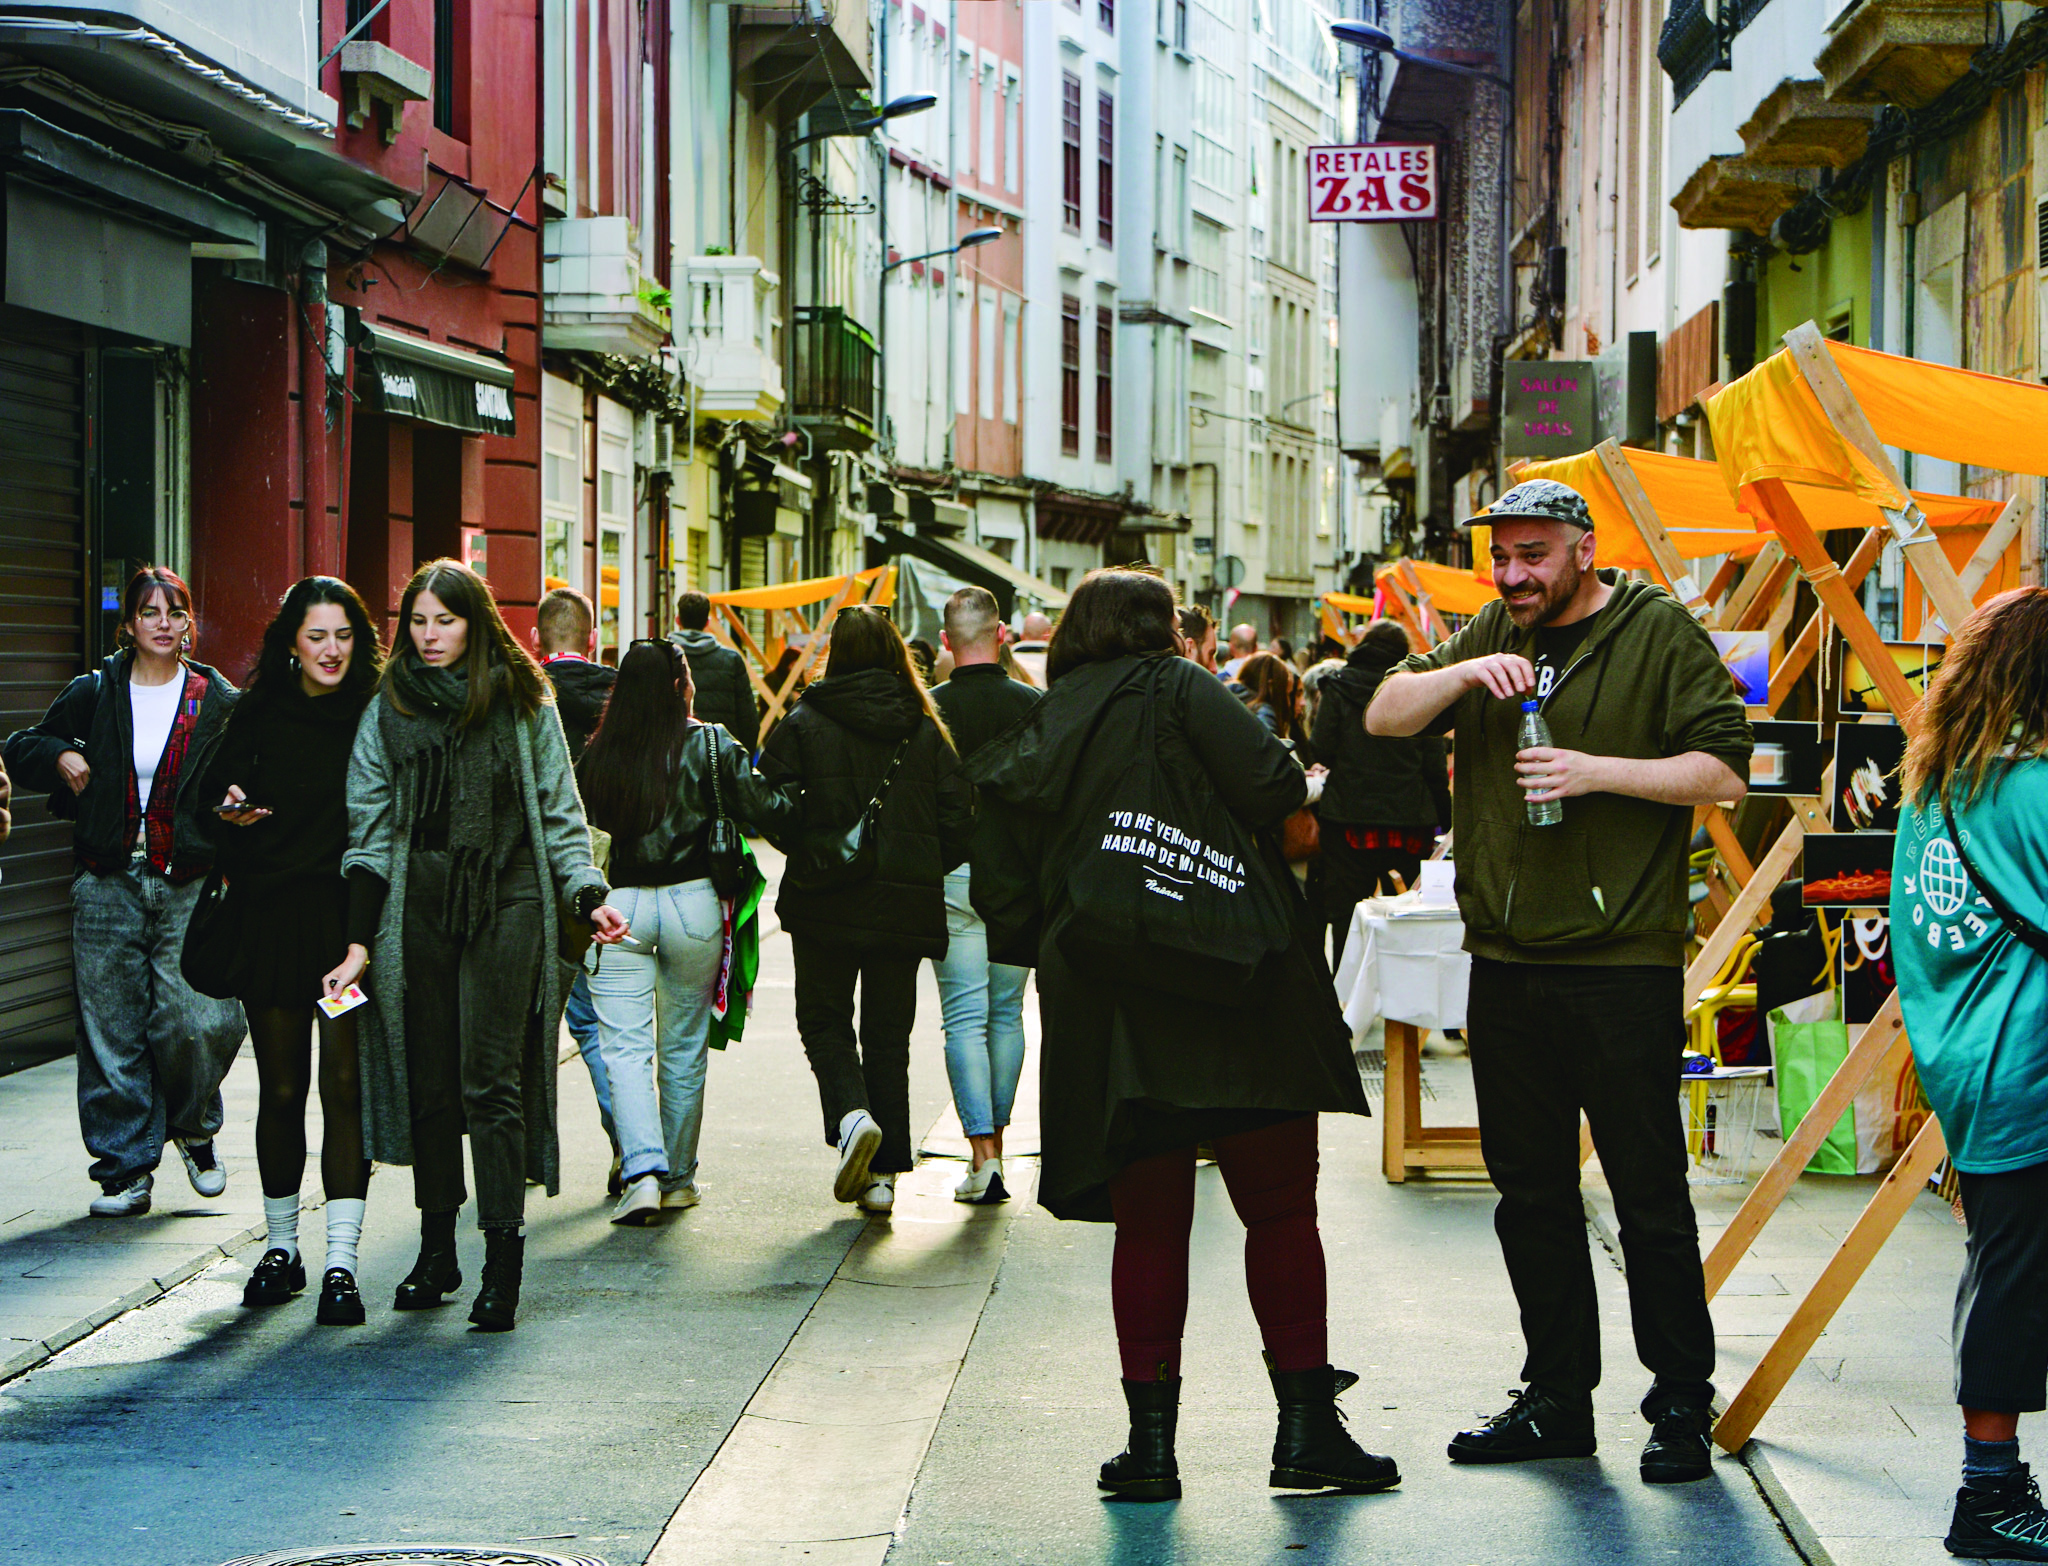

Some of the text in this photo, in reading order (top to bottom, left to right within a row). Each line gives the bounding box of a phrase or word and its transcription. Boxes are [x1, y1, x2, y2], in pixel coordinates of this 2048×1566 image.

[1316, 150, 1429, 173] RETALES
[1316, 174, 1431, 213] ZAS
[1520, 373, 1578, 393] SALÓN
[1537, 400, 1559, 415] DE
[1101, 834, 1157, 859] HABLAR
[1158, 846, 1177, 869] DE
[1178, 854, 1194, 873] MI
[1134, 812, 1155, 833] HE
[1156, 820, 1201, 856] VENIDO
[1203, 845, 1235, 873] AQUÍ
[1236, 862, 1245, 876] A
